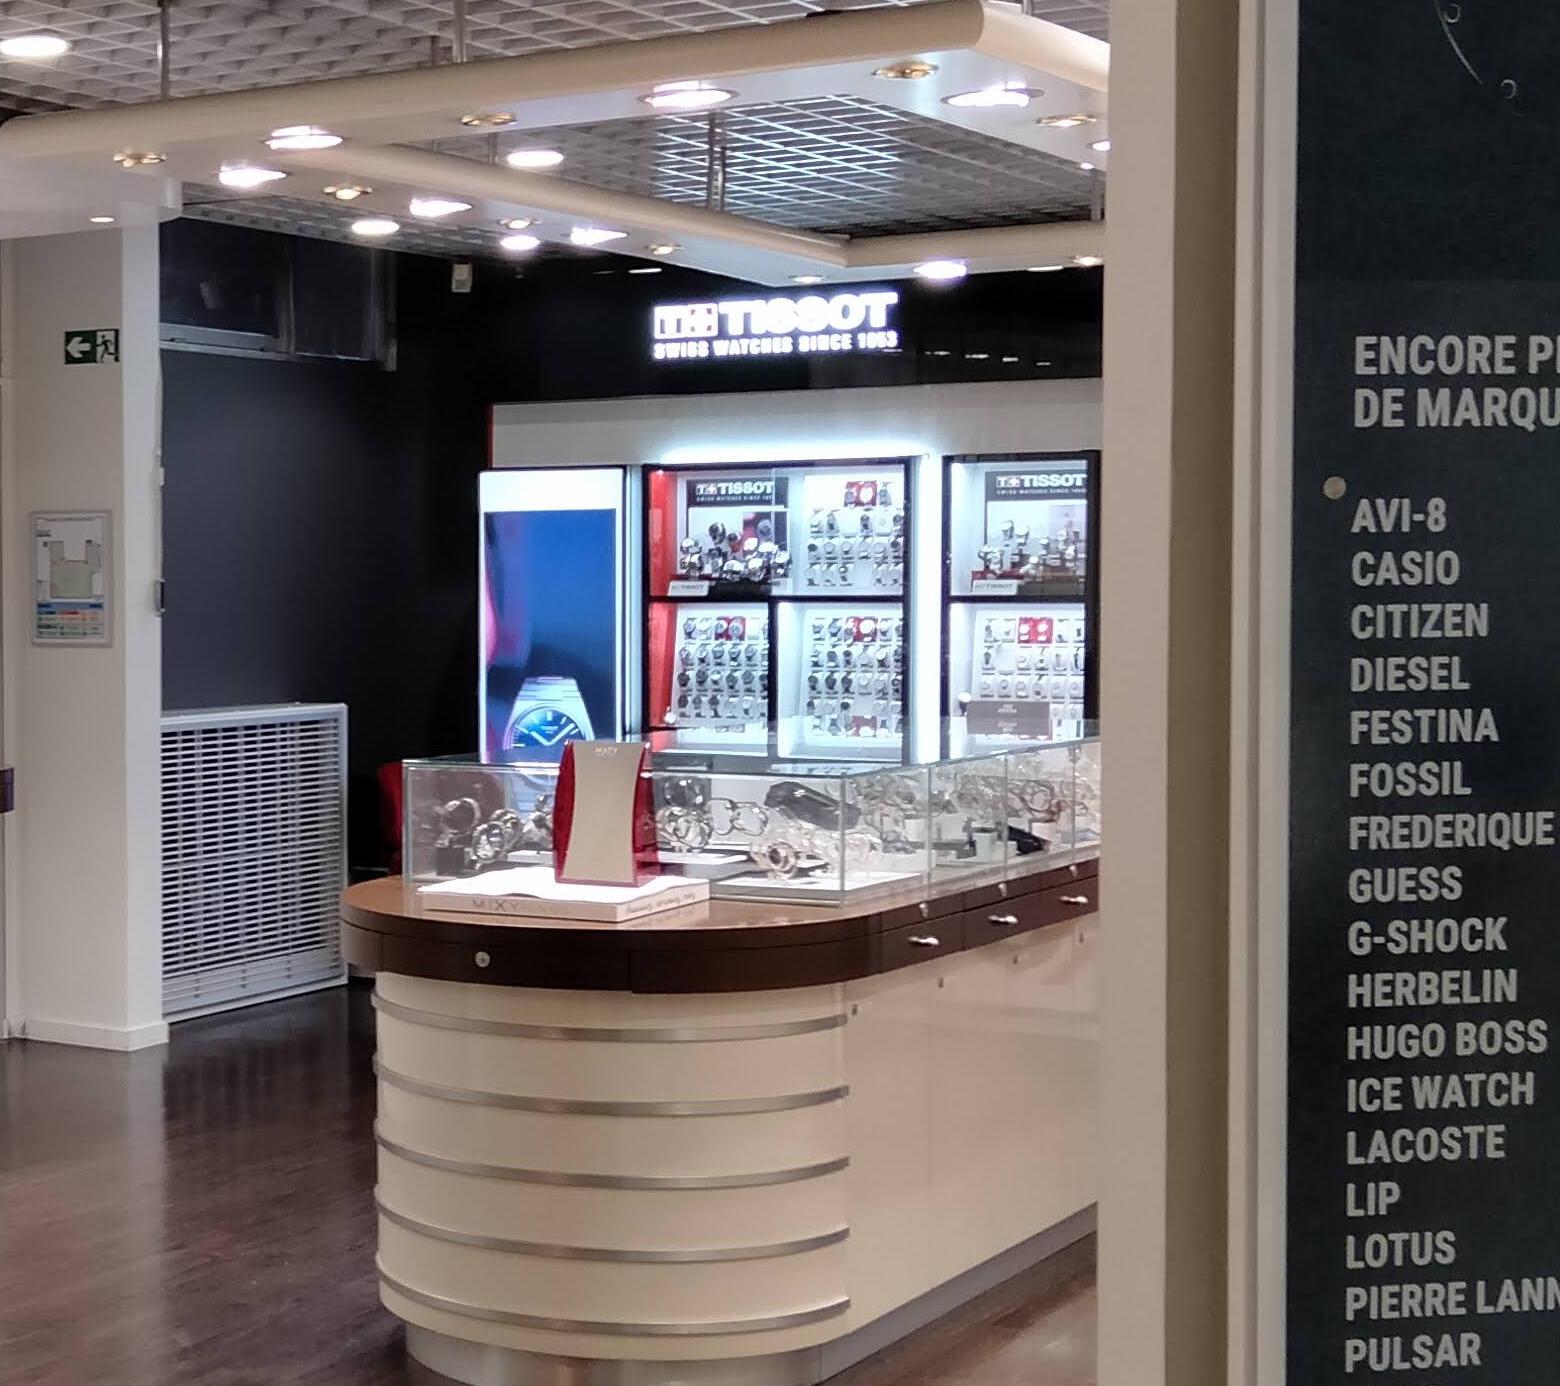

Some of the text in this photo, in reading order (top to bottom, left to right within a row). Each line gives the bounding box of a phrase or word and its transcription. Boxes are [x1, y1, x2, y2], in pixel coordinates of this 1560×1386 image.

[719, 292, 899, 336] TISSOT
[1354, 334, 1517, 376] ENCORE
[1354, 387, 1405, 428] DE
[718, 481, 774, 495] TISSOT
[1020, 473, 1087, 488] TISSOT
[1350, 496, 1447, 534] AVI-8
[1351, 549, 1460, 587] CASIO
[1350, 602, 1489, 640] CITIZEN
[1350, 655, 1471, 692] DIESEL
[1349, 707, 1500, 745] FESTINA
[1349, 760, 1473, 798] FOSSIL
[1349, 810, 1556, 852] FREDERIQUE
[1348, 865, 1463, 904] GUESS
[1348, 916, 1508, 956] G-SHOCK
[1347, 968, 1518, 1009] HERBELIN
[1347, 1018, 1548, 1061] HUGO BOSS
[1347, 1071, 1535, 1113] ICE WATCH
[1346, 1124, 1506, 1165] LACOSTE
[1346, 1181, 1401, 1217] LIP
[1346, 1230, 1456, 1270] LOTUS
[1345, 1281, 1467, 1322] PIERRE
[1345, 1331, 1482, 1373] PULSAR
